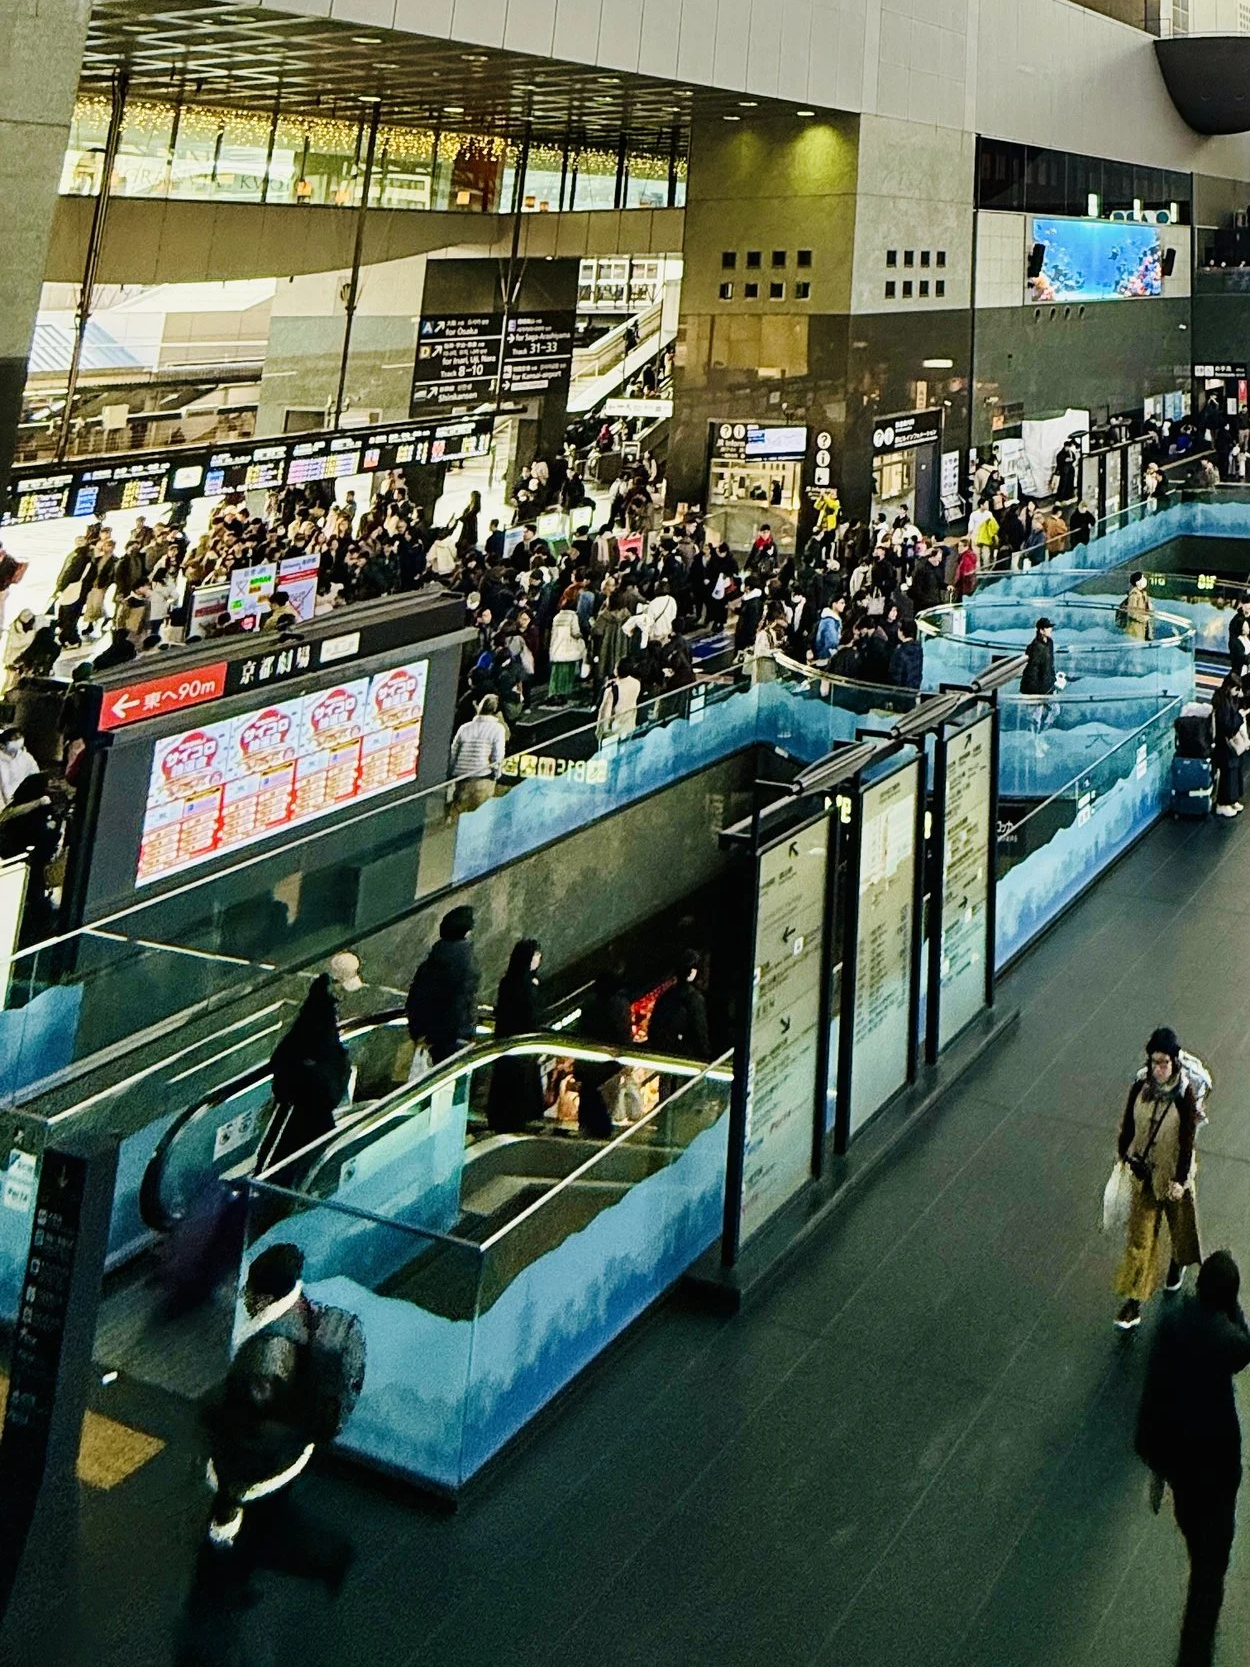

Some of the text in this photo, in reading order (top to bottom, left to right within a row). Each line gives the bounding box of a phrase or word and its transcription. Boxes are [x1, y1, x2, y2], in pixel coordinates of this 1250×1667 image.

[422, 321, 433, 334] A
[457, 326, 478, 335] Osaka
[420, 345, 431, 358] D
[529, 342, 558, 354] 31-33
[480, 355, 496, 363] Nara
[440, 363, 484, 378] Track 8-10
[438, 391, 478, 403] Shinkansen
